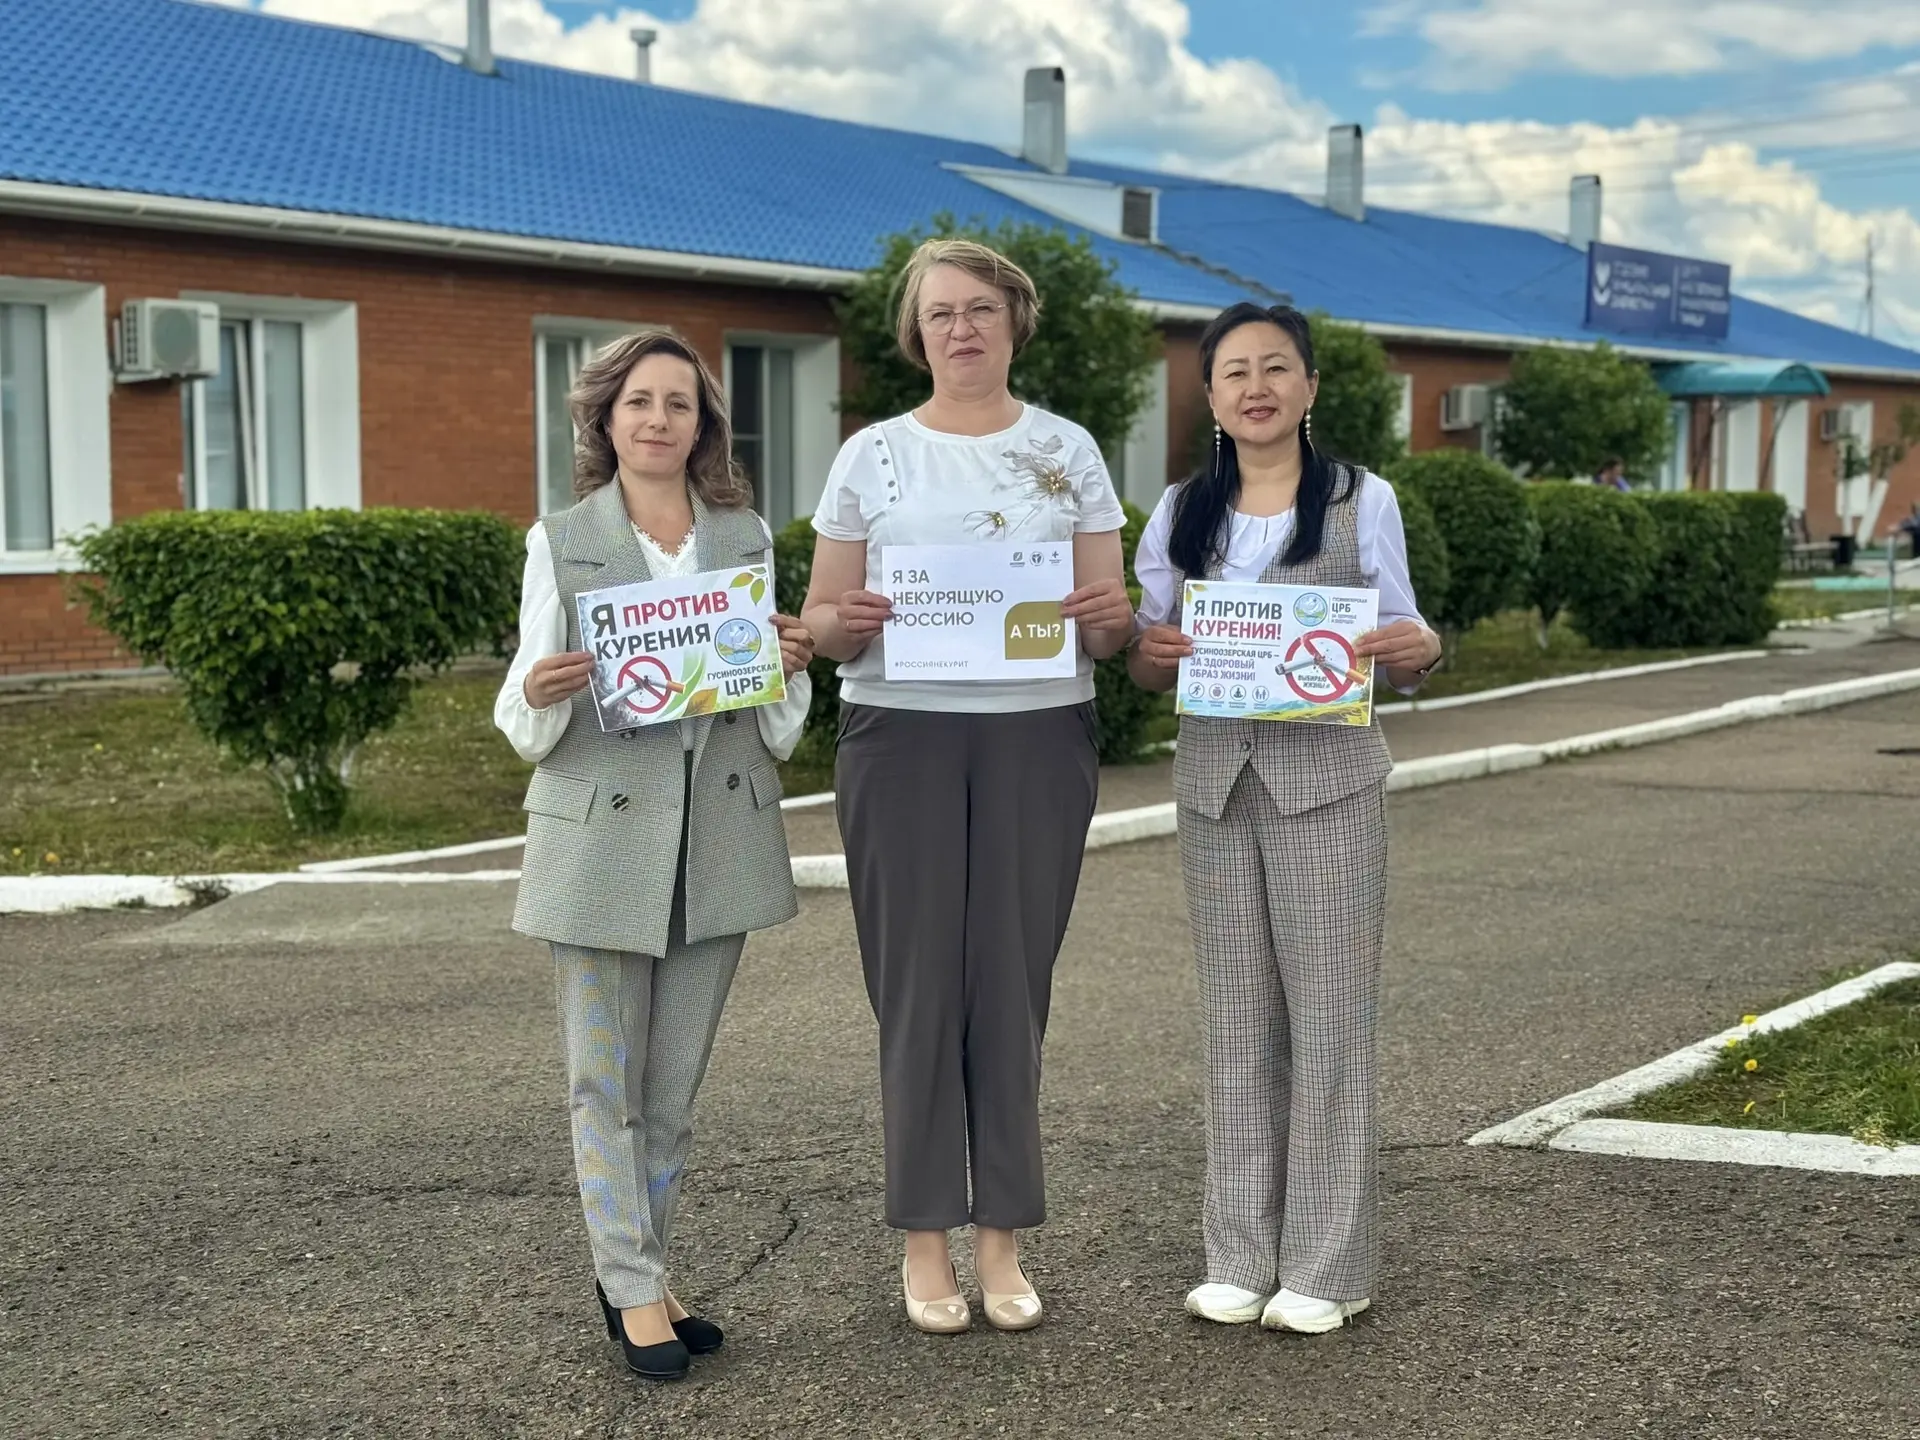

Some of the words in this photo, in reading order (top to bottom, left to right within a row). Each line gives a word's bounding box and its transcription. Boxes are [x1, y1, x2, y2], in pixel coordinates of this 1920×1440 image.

[892, 570, 903, 583] Я
[908, 569, 930, 583] ЗА
[893, 589, 1004, 606] НЕКУРЯЩУЮ
[591, 603, 617, 638] Я
[623, 591, 729, 628] ПРОТИВ
[1193, 600, 1206, 616] Я
[1211, 600, 1282, 620] ПРОТИВ
[1332, 603, 1351, 613] ЦРБ
[893, 612, 974, 627] РОССИЮ
[1010, 624, 1022, 639] А
[1026, 623, 1061, 638] ТЫ?
[1192, 619, 1282, 640] КУРЕНИЯ!
[595, 623, 711, 661] КУРЕНИЯ
[1257, 650, 1273, 659] ЦРБ
[895, 660, 969, 668] #РОССИЯНЕКУРИТ
[1190, 657, 1202, 667] ЗА
[1204, 658, 1255, 669] ЗДОРОВЫЙ
[707, 663, 777, 681] ГУСИНООЗЕРСКАЯ
[1189, 669, 1218, 679] ОБРАЗ
[1220, 671, 1256, 681] ЖИЗНИ!
[725, 676, 764, 697] ЦРБ
